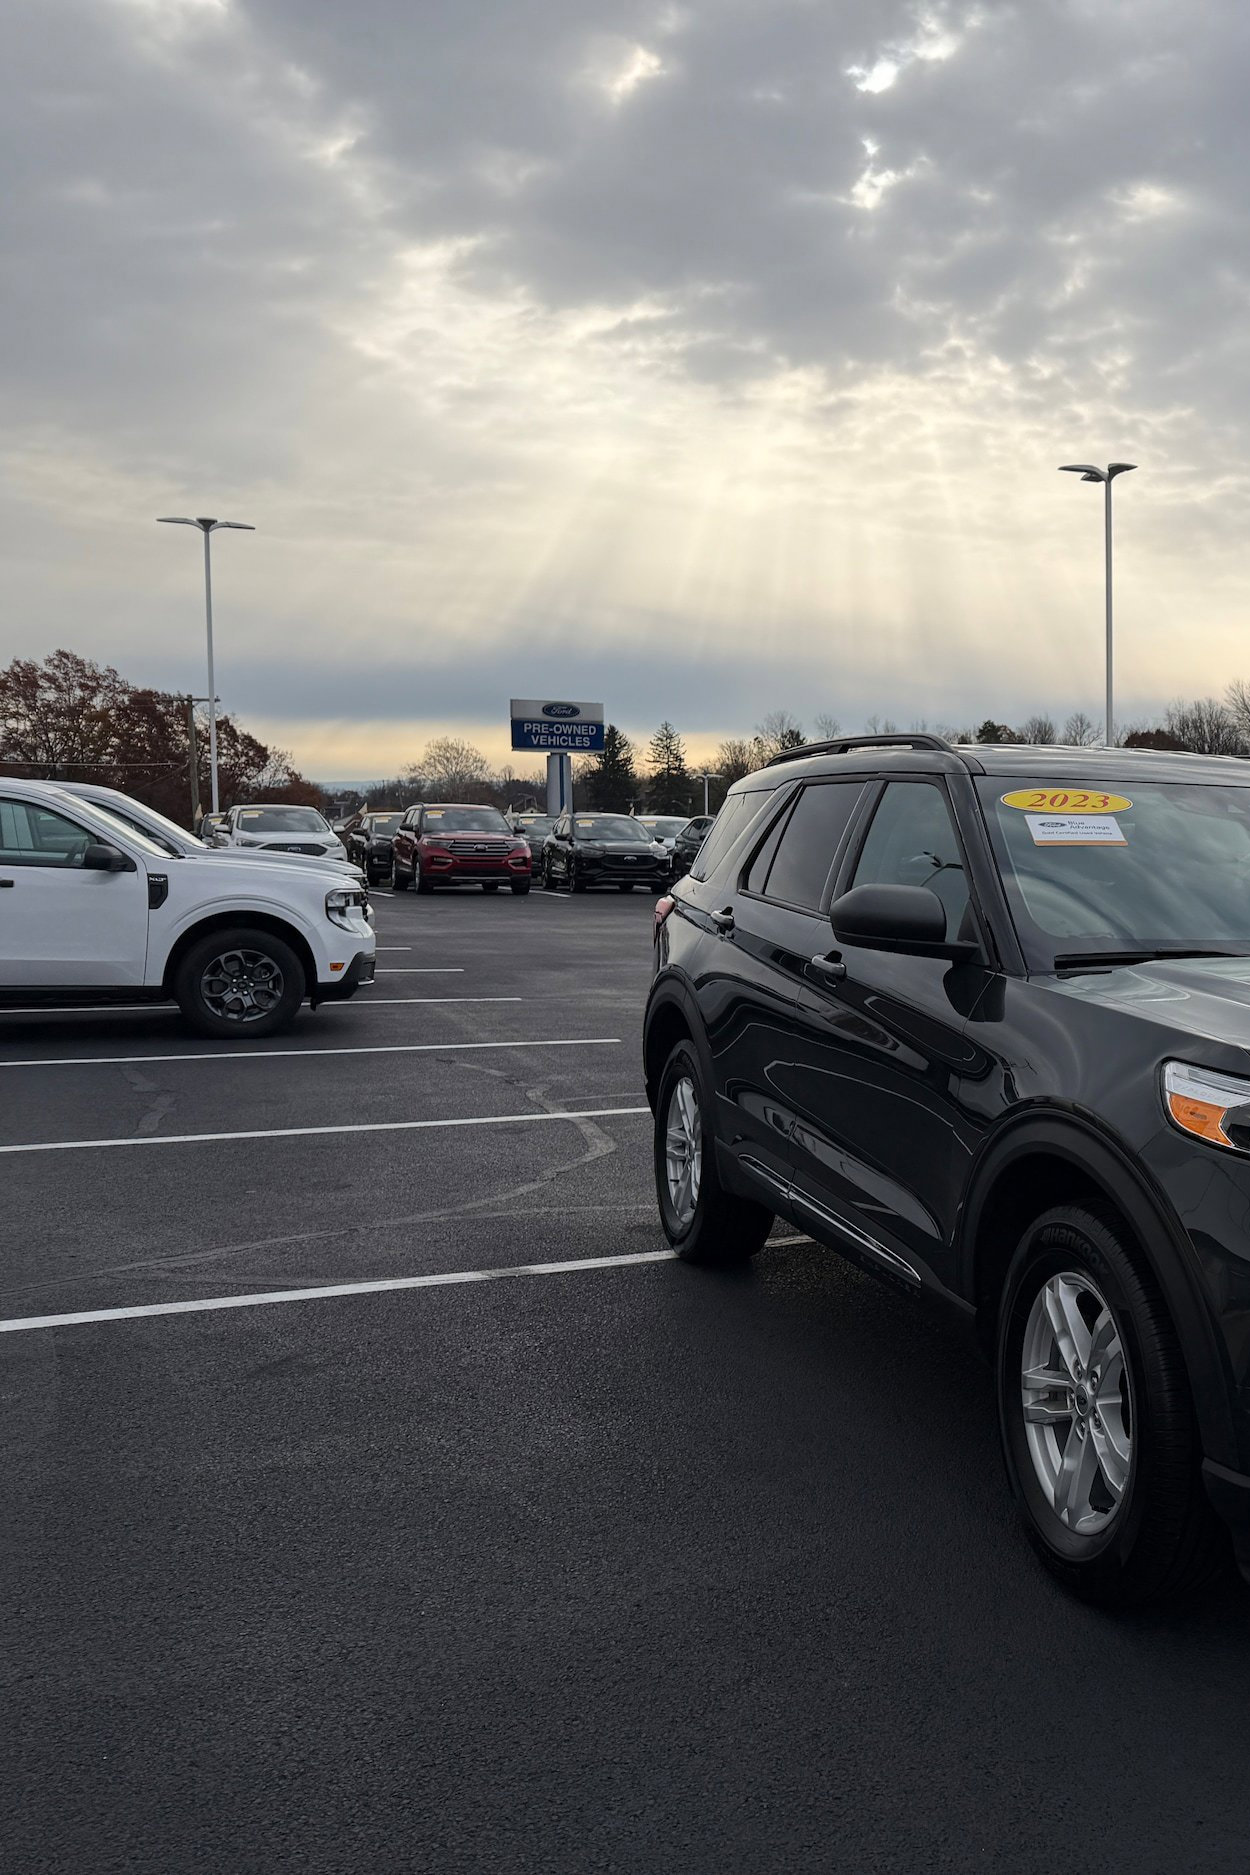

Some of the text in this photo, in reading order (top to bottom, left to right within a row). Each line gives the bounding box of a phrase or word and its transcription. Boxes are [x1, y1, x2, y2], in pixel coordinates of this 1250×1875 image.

[523, 722, 597, 736] PRE-OWNED
[531, 734, 591, 747] VEHICLES
[1027, 793, 1110, 809] 2023
